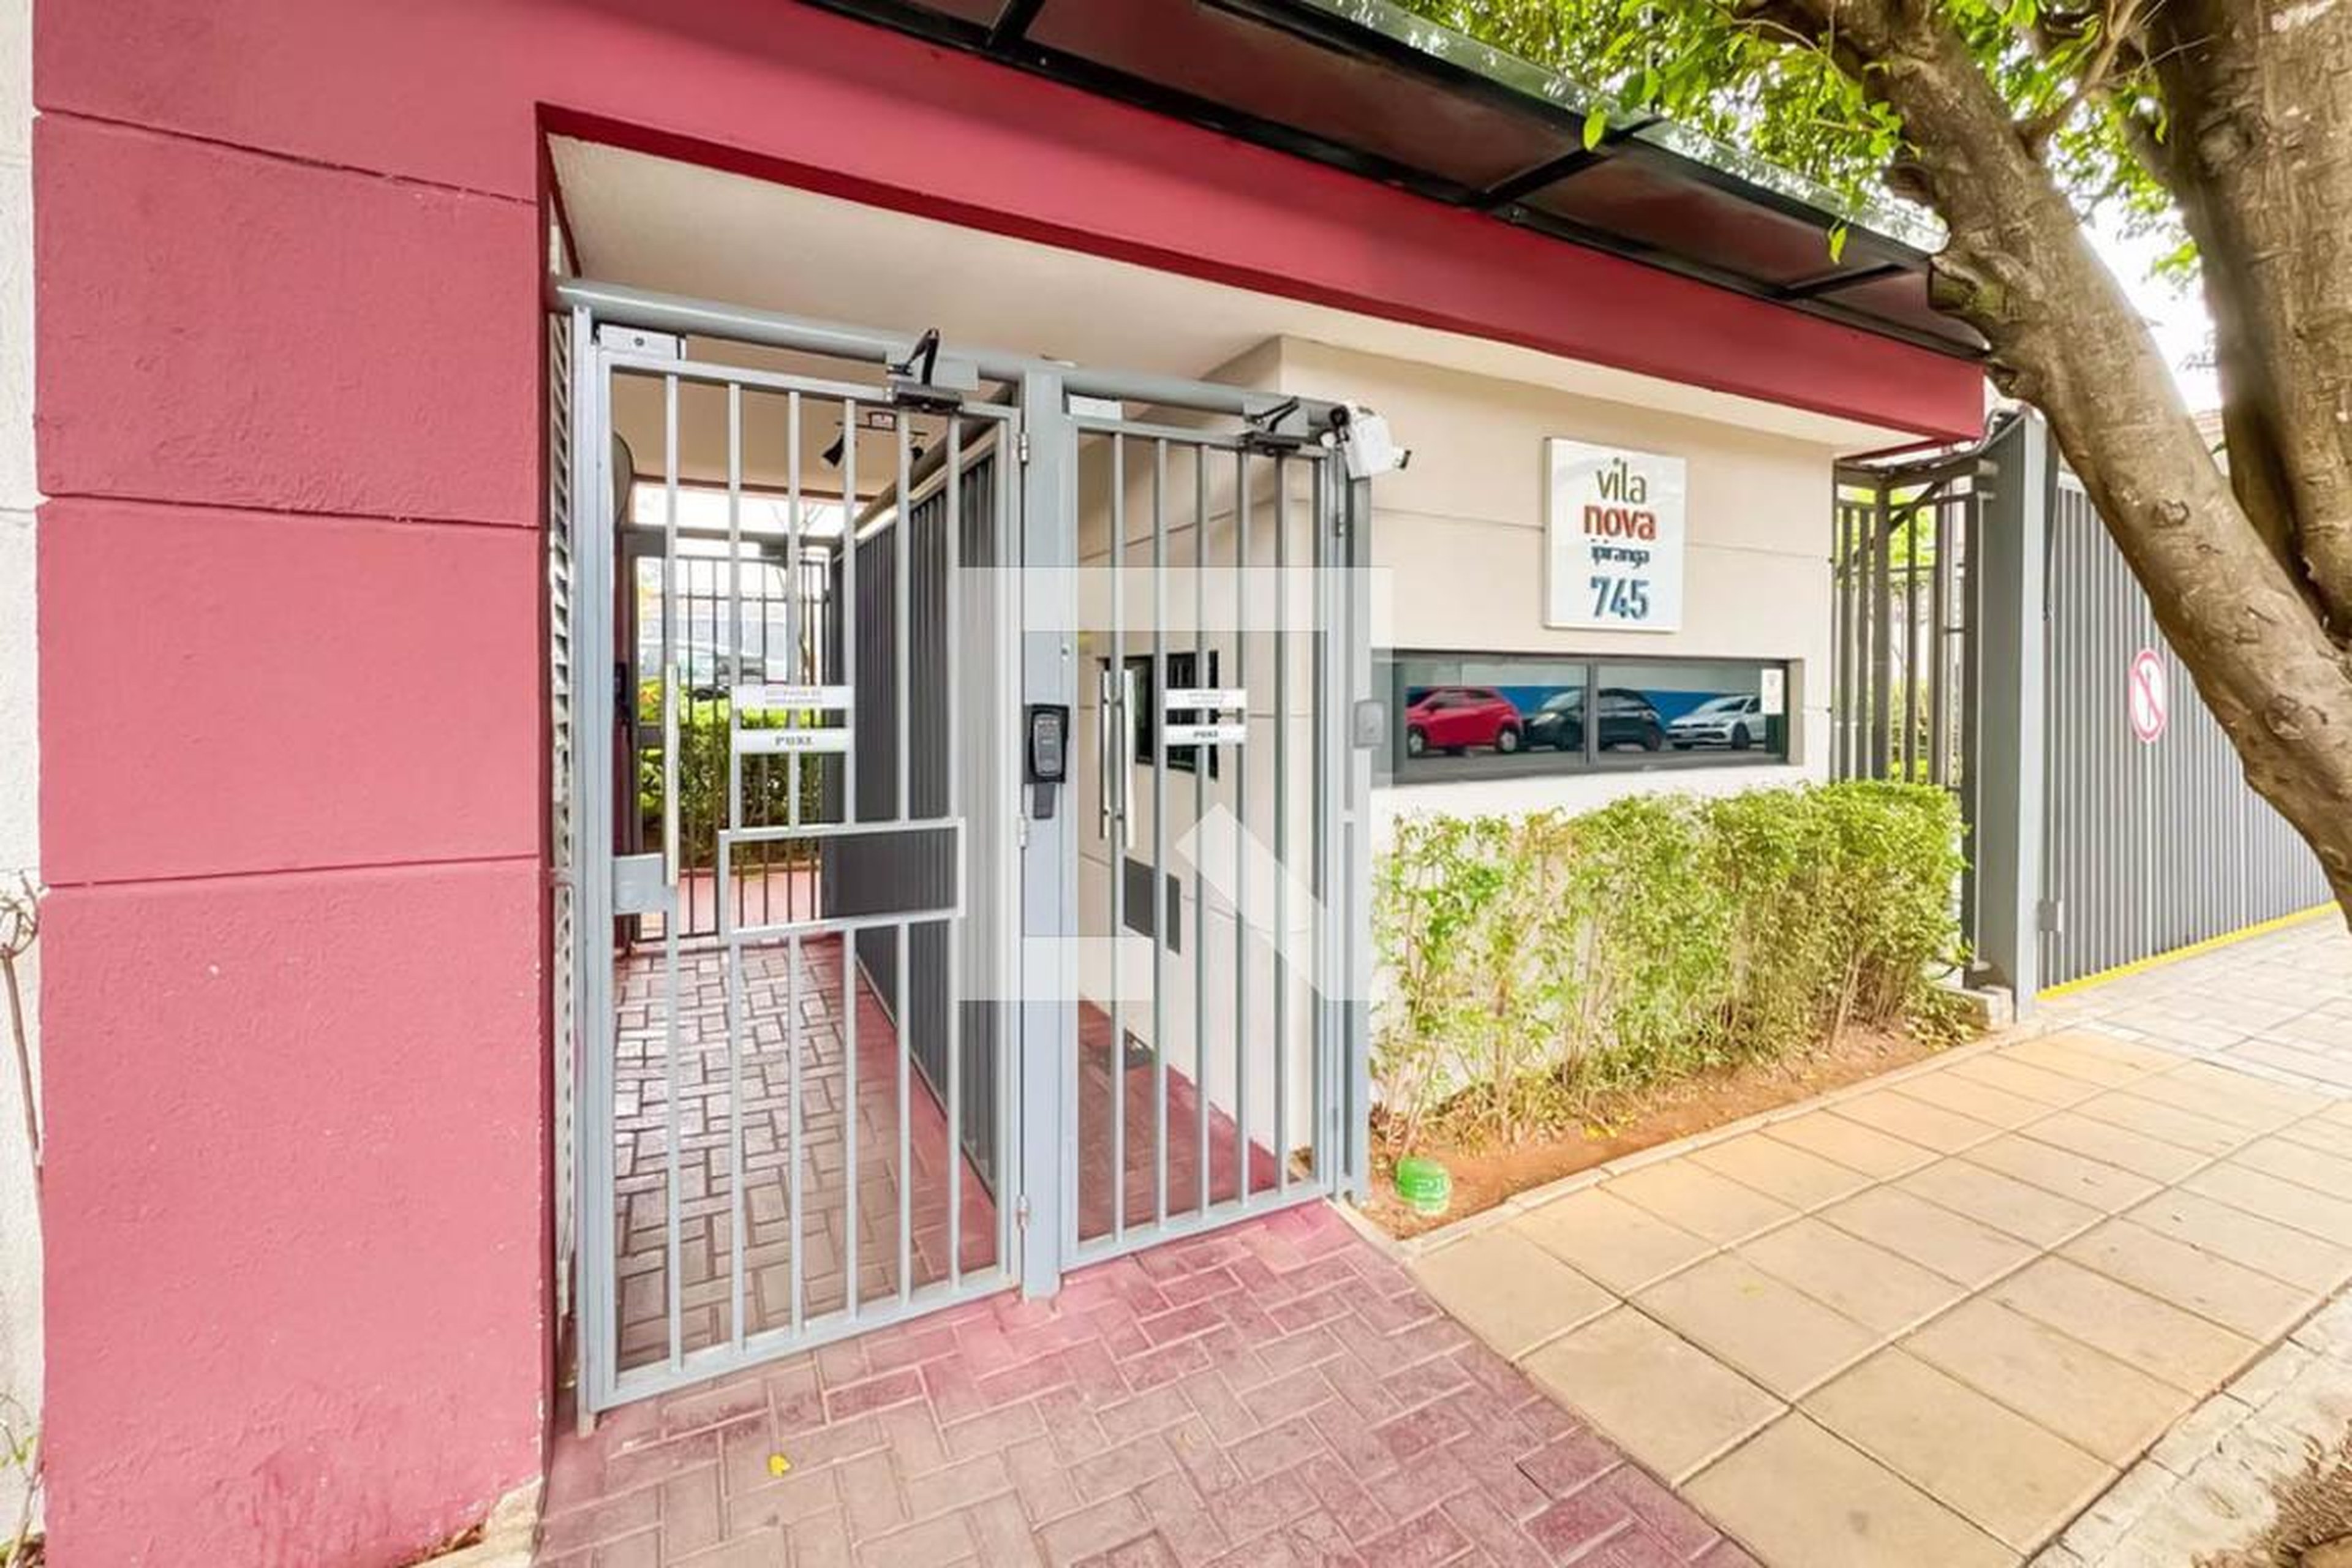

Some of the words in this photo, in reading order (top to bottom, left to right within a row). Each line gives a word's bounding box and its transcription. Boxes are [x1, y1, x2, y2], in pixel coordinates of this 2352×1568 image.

[1596, 458, 1647, 504] vila
[1584, 505, 1656, 540] nova
[1591, 576, 1649, 619] 745
